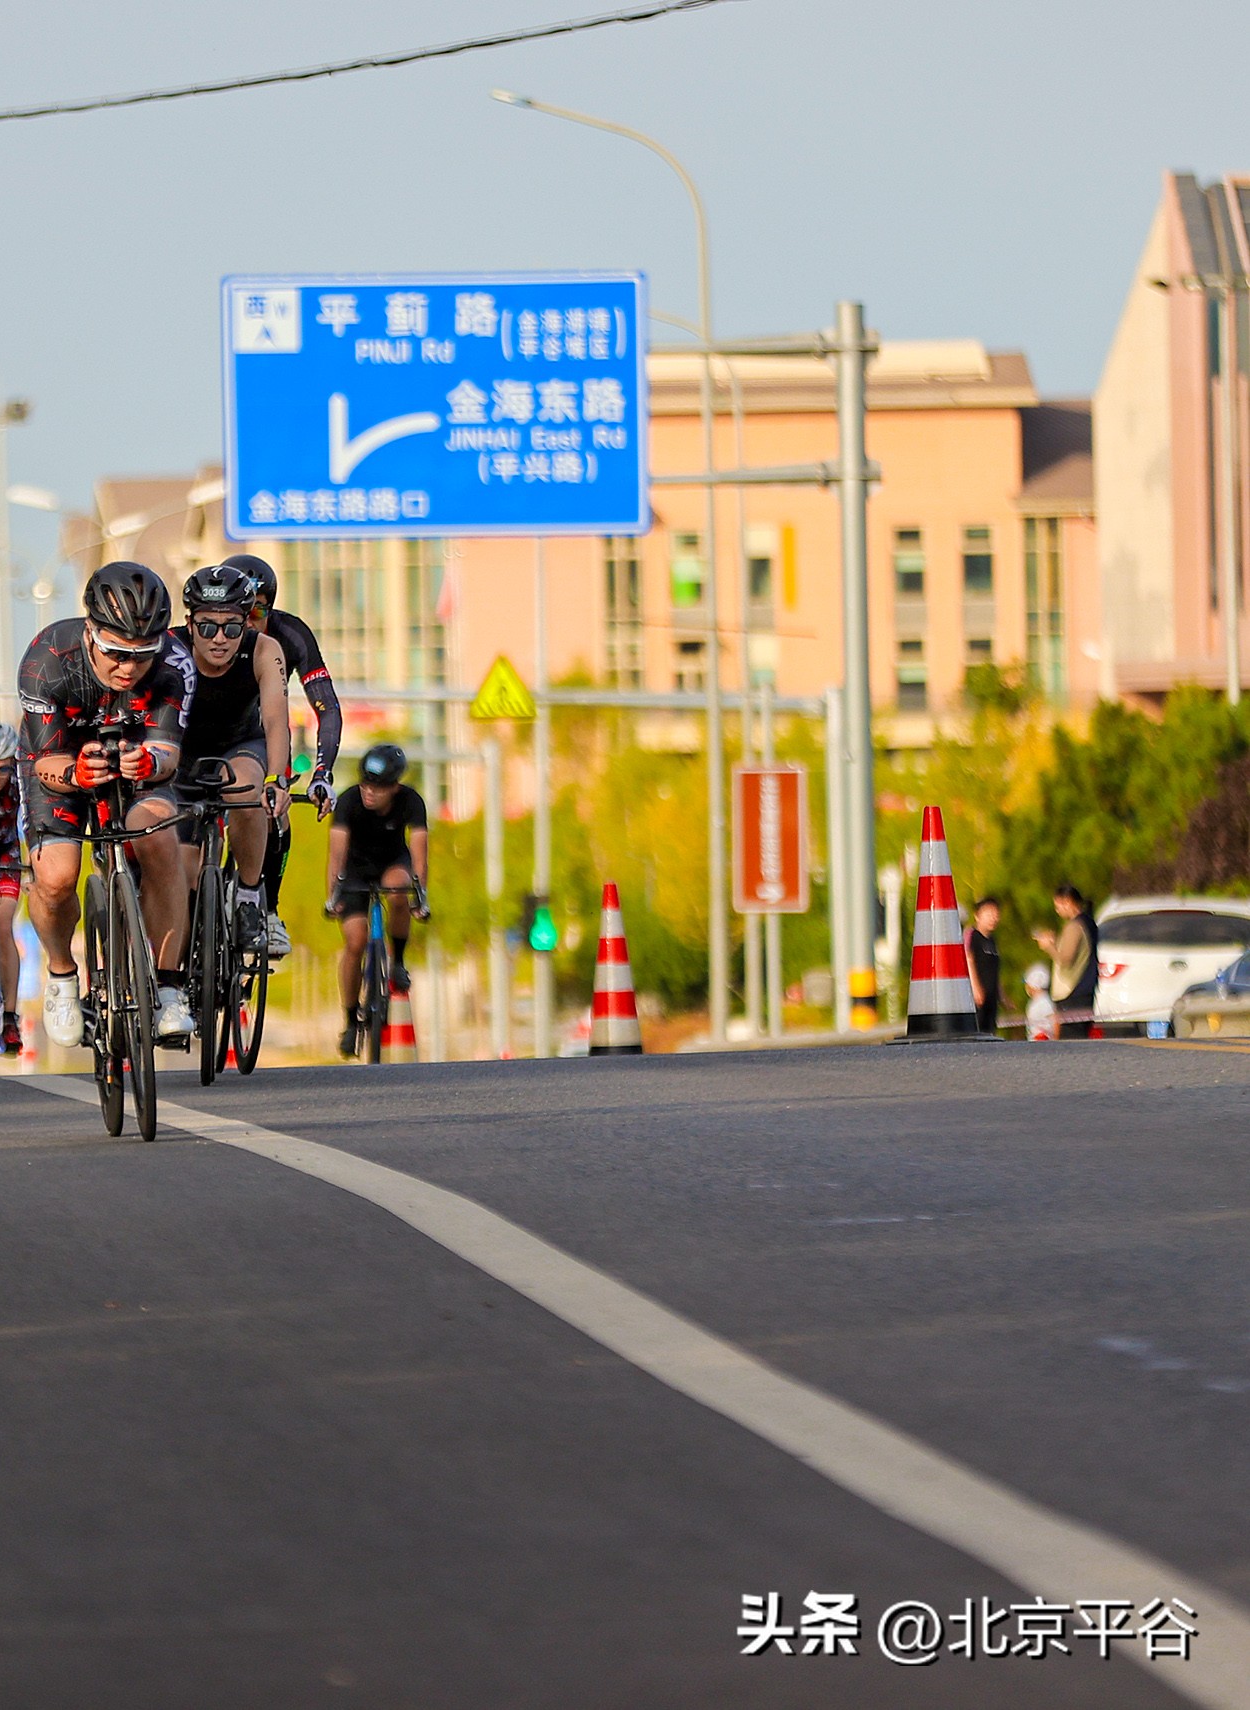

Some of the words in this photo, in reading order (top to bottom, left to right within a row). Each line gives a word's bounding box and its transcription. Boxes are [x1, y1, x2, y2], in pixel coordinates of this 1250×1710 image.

[316, 291, 498, 338] 平蓟路
[355, 338, 411, 365] PINJI
[421, 337, 455, 364] Rd
[446, 378, 626, 425] 金海东路
[444, 427, 520, 452] JINHAI
[530, 425, 582, 451] East
[592, 424, 627, 450] Rd
[249, 488, 430, 523] 金海东路路口
[203, 588, 225, 597] 3038
